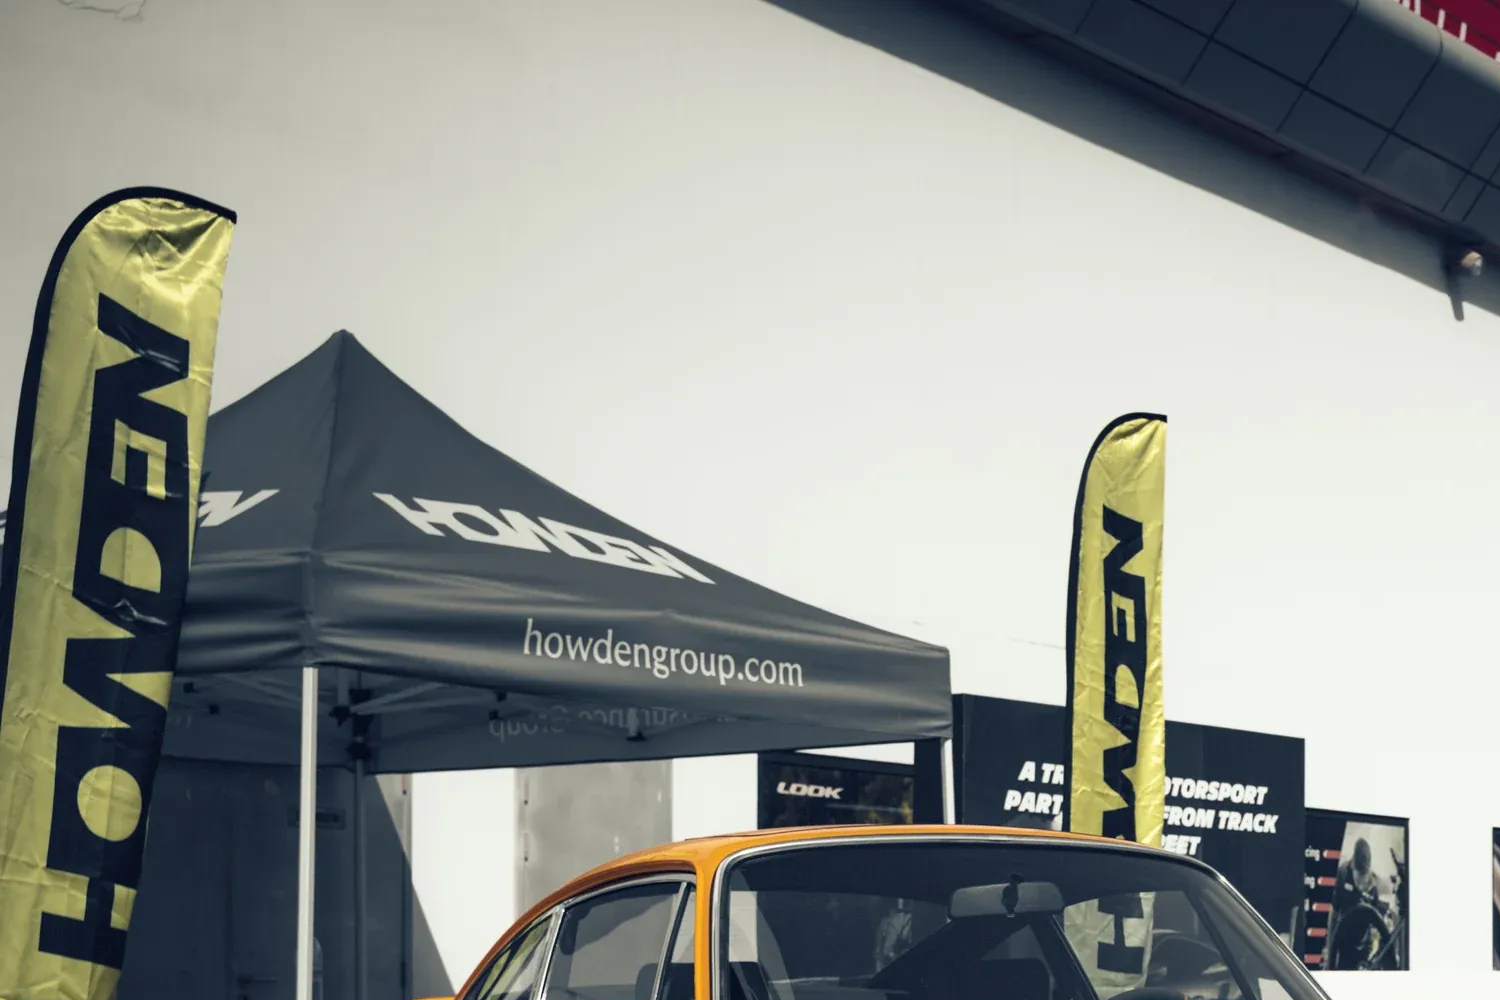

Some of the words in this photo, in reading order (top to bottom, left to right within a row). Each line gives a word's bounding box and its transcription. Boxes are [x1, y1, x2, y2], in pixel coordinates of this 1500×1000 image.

[372, 491, 716, 585] HOWDEN
[38, 292, 190, 969] HOWDEN
[523, 617, 805, 687] howdengroup.com
[775, 780, 844, 800] LOOK
[1017, 760, 1036, 783] A
[1041, 762, 1064, 785] TR
[1003, 789, 1063, 815] PART
[1217, 809, 1280, 834] TRACK
